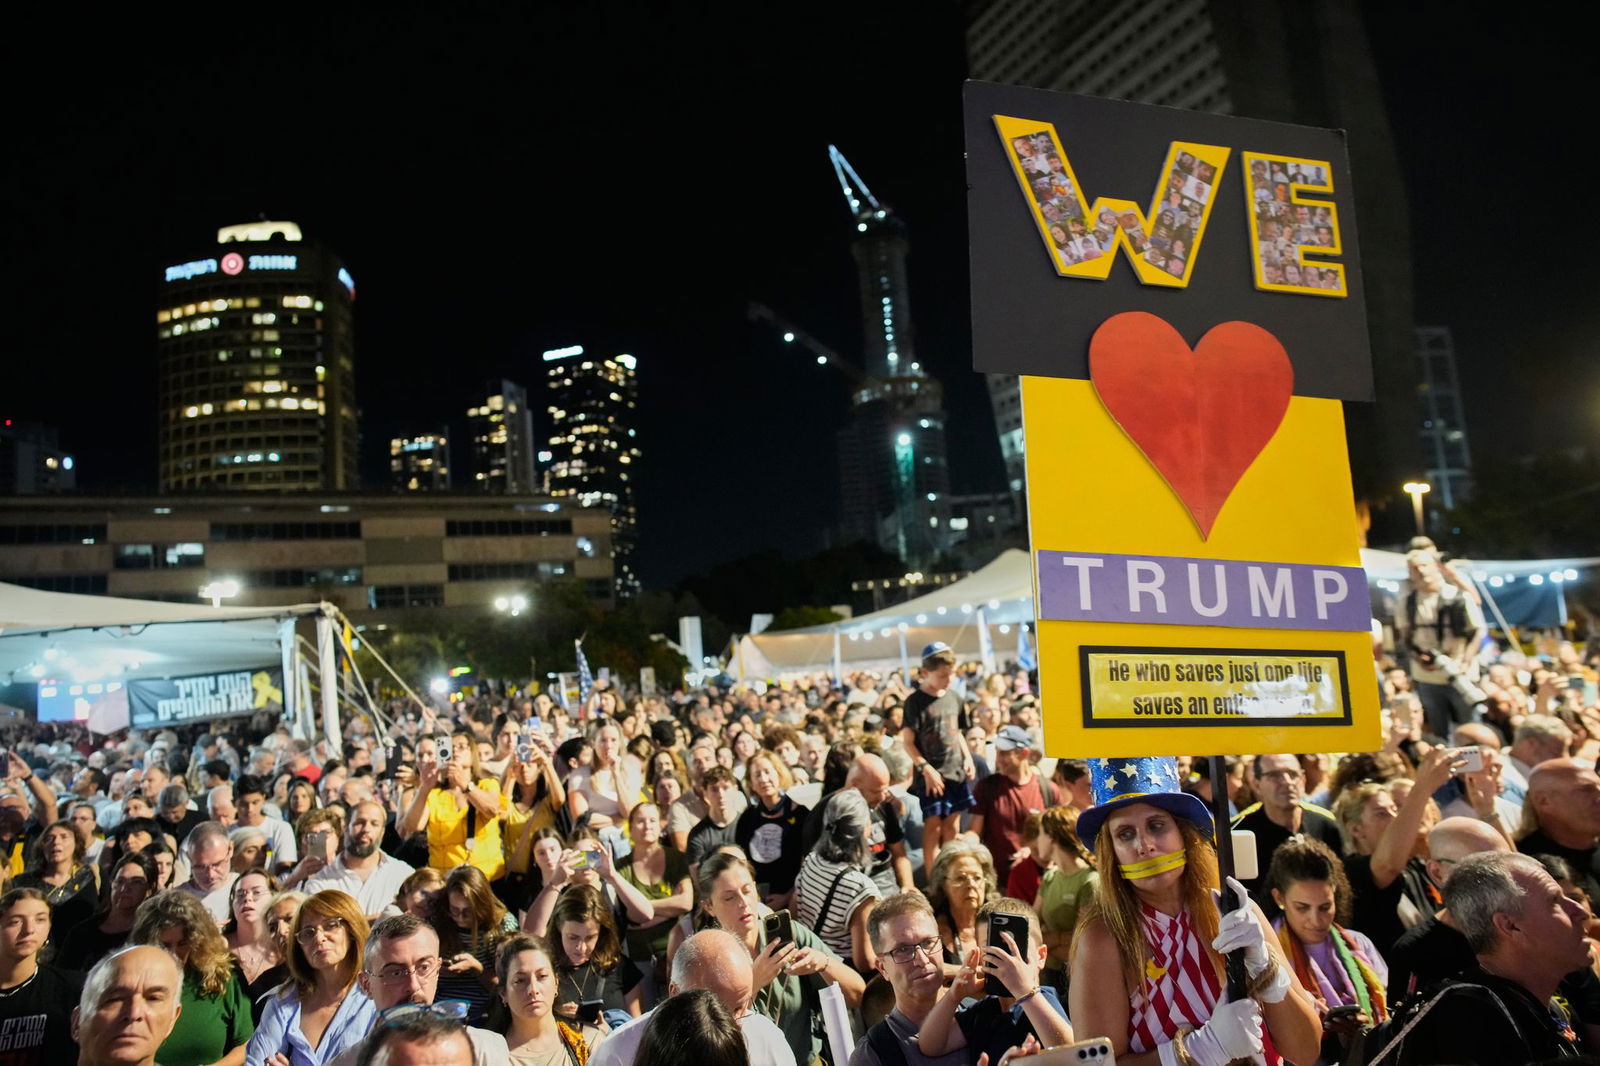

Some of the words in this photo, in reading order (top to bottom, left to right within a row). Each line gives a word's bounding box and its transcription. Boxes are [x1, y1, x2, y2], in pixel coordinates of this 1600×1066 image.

[992, 114, 1347, 298] WE
[1062, 556, 1349, 620] TRUMP
[217, 672, 252, 695] העם
[1109, 659, 1130, 682] He
[1136, 660, 1170, 682] who
[1175, 663, 1224, 682] saves
[1229, 660, 1260, 684] just
[1265, 664, 1293, 682] one
[1297, 661, 1322, 683] life
[174, 675, 216, 698] יחזיר
[157, 695, 228, 721] החטופים
[229, 692, 254, 713] את
[1133, 696, 1183, 715] saves
[1188, 697, 1208, 715] an
